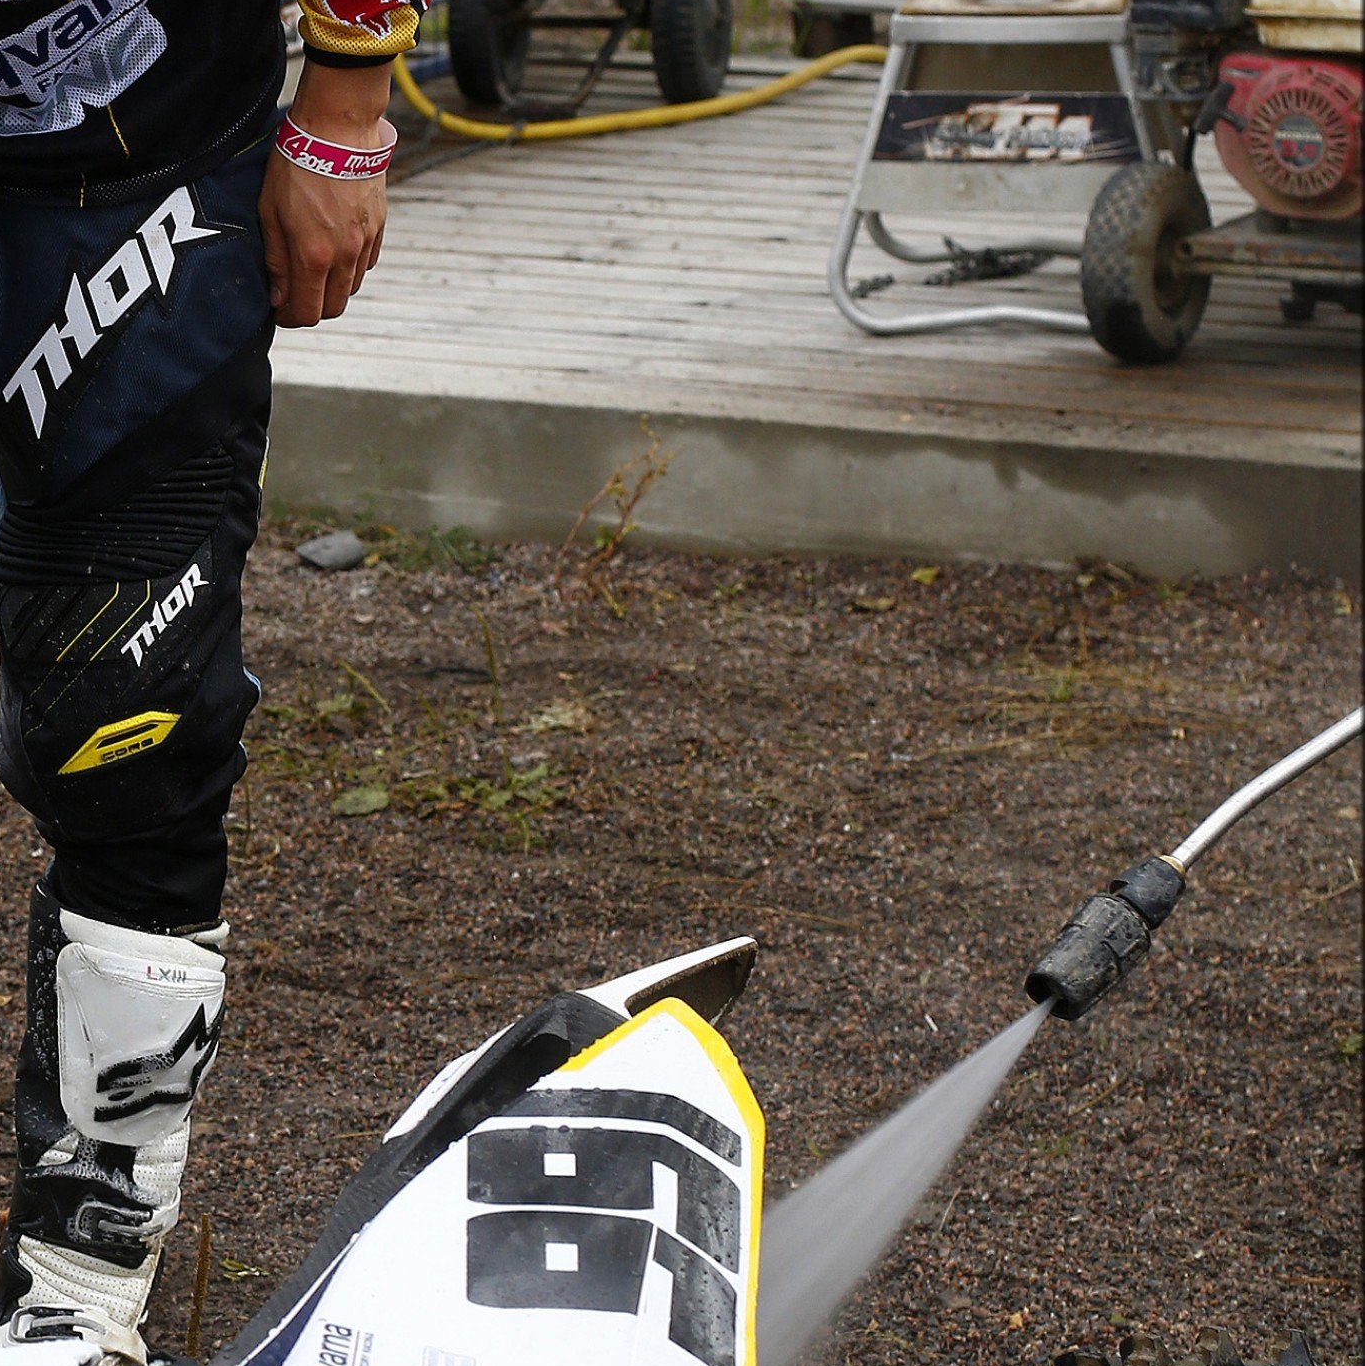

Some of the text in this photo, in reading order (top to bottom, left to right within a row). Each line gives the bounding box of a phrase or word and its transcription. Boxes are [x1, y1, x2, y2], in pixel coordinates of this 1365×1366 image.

[295, 151, 334, 172] 2014
[3, 185, 222, 439] THOR
[120, 562, 210, 668] THOR
